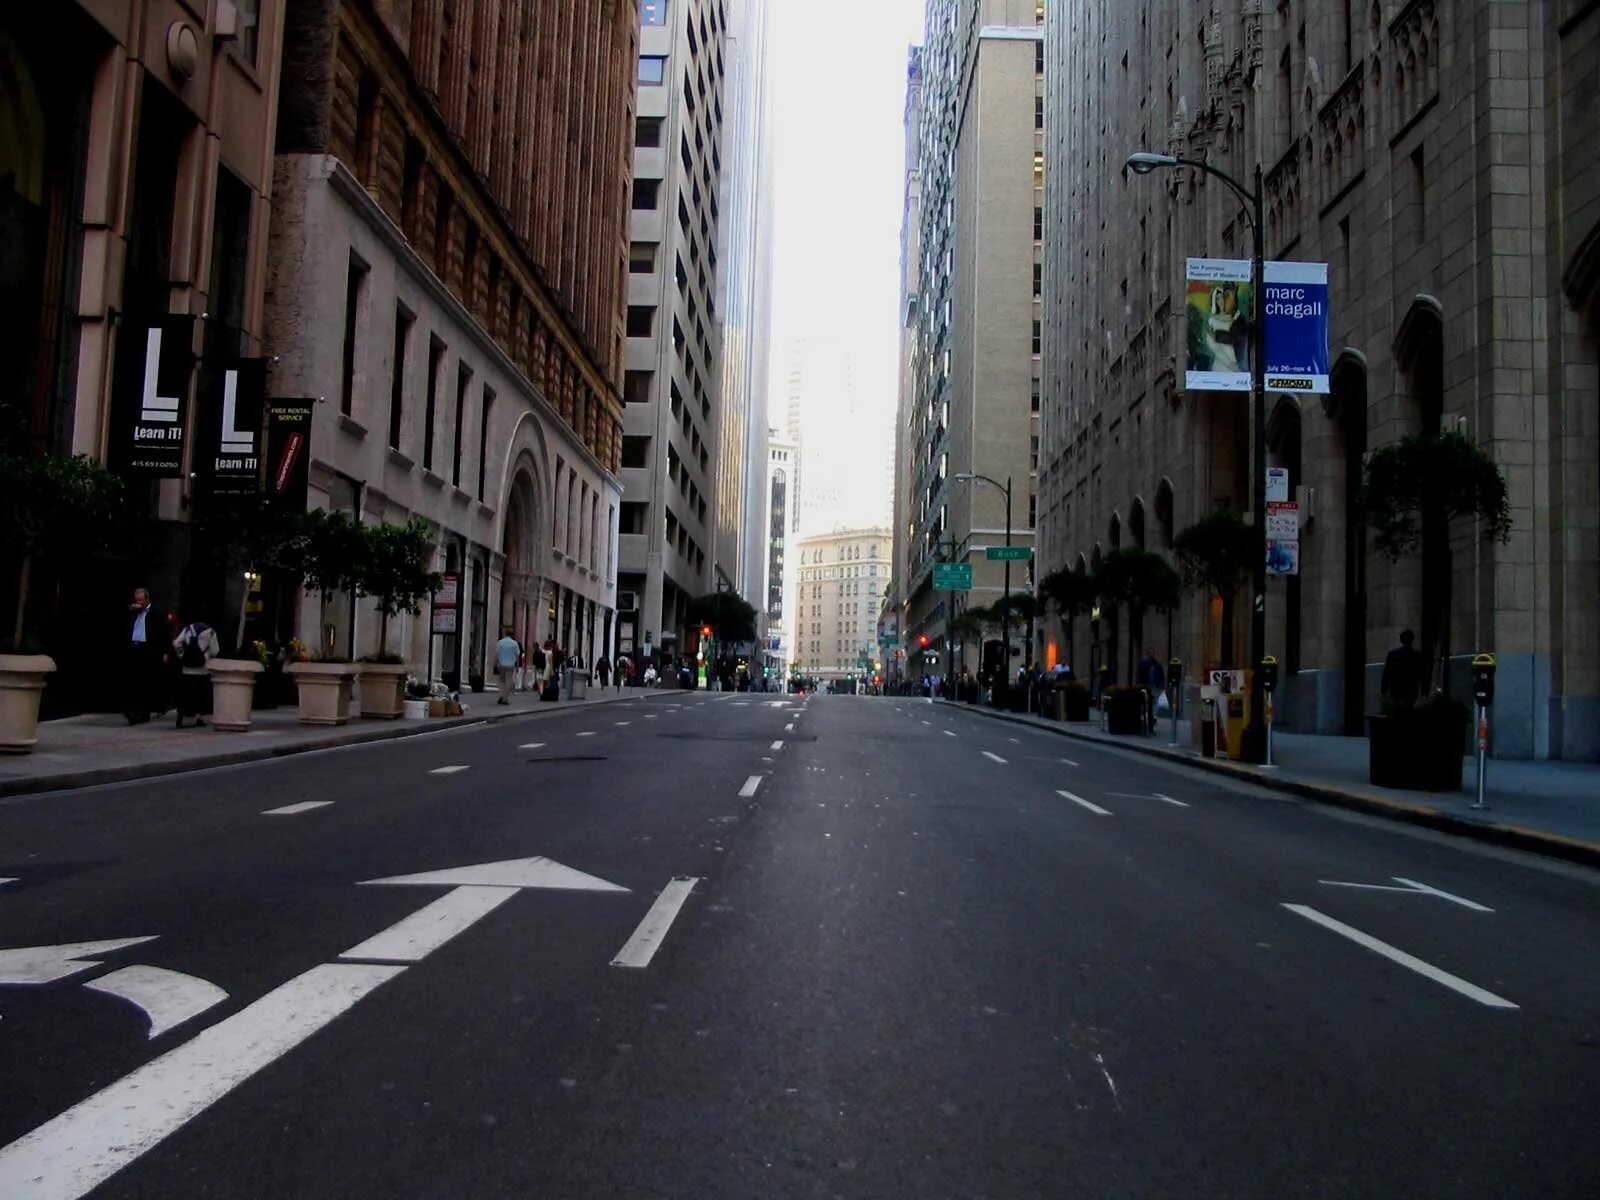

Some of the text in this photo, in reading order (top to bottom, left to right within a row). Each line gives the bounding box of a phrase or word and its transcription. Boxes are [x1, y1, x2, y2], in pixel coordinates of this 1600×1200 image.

[1265, 287, 1305, 300] marc
[1265, 300, 1321, 319] chagall
[287, 407, 311, 415] RENTAL
[134, 425, 166, 441] Learn
[214, 456, 242, 471] Learn
